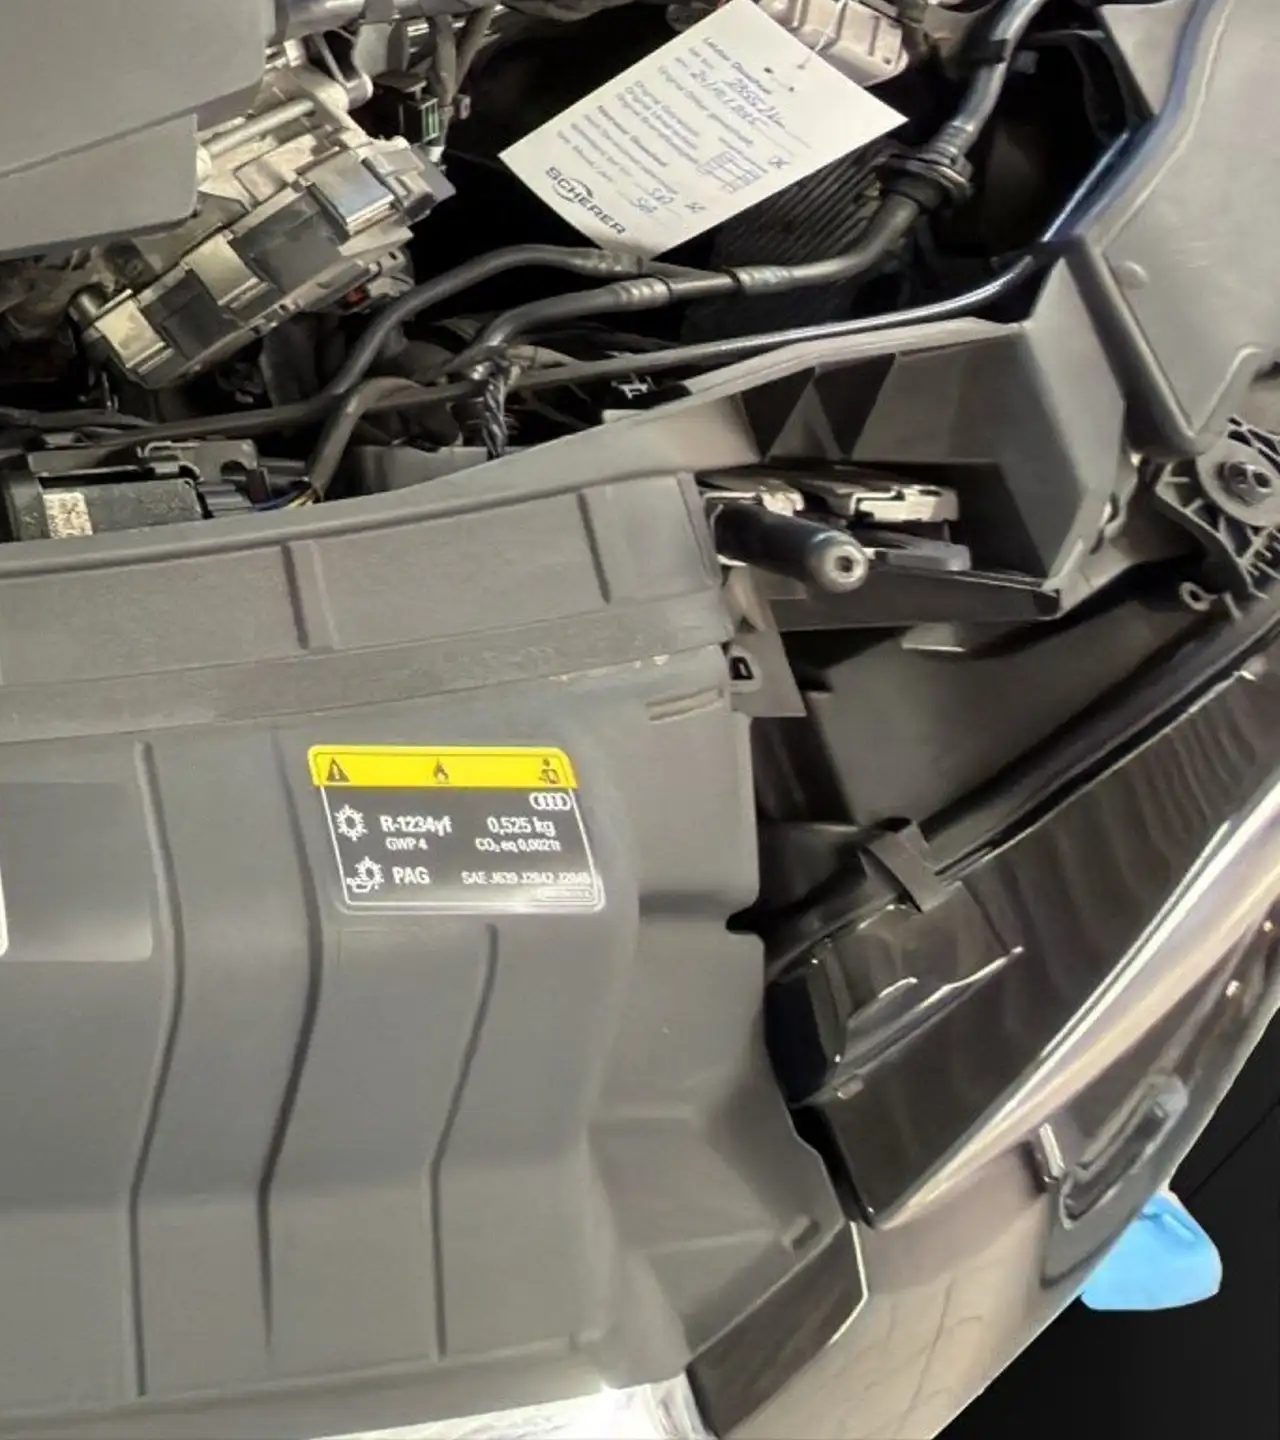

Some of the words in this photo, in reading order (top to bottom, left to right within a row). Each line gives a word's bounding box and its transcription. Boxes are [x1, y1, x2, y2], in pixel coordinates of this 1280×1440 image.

[545, 166, 627, 234] SCHERER
[380, 815, 452, 837] R-1234yf
[487, 816, 532, 836] 0,525
[532, 816, 556, 837] kg
[385, 836, 417, 851] GWP
[392, 866, 430, 884] PAG
